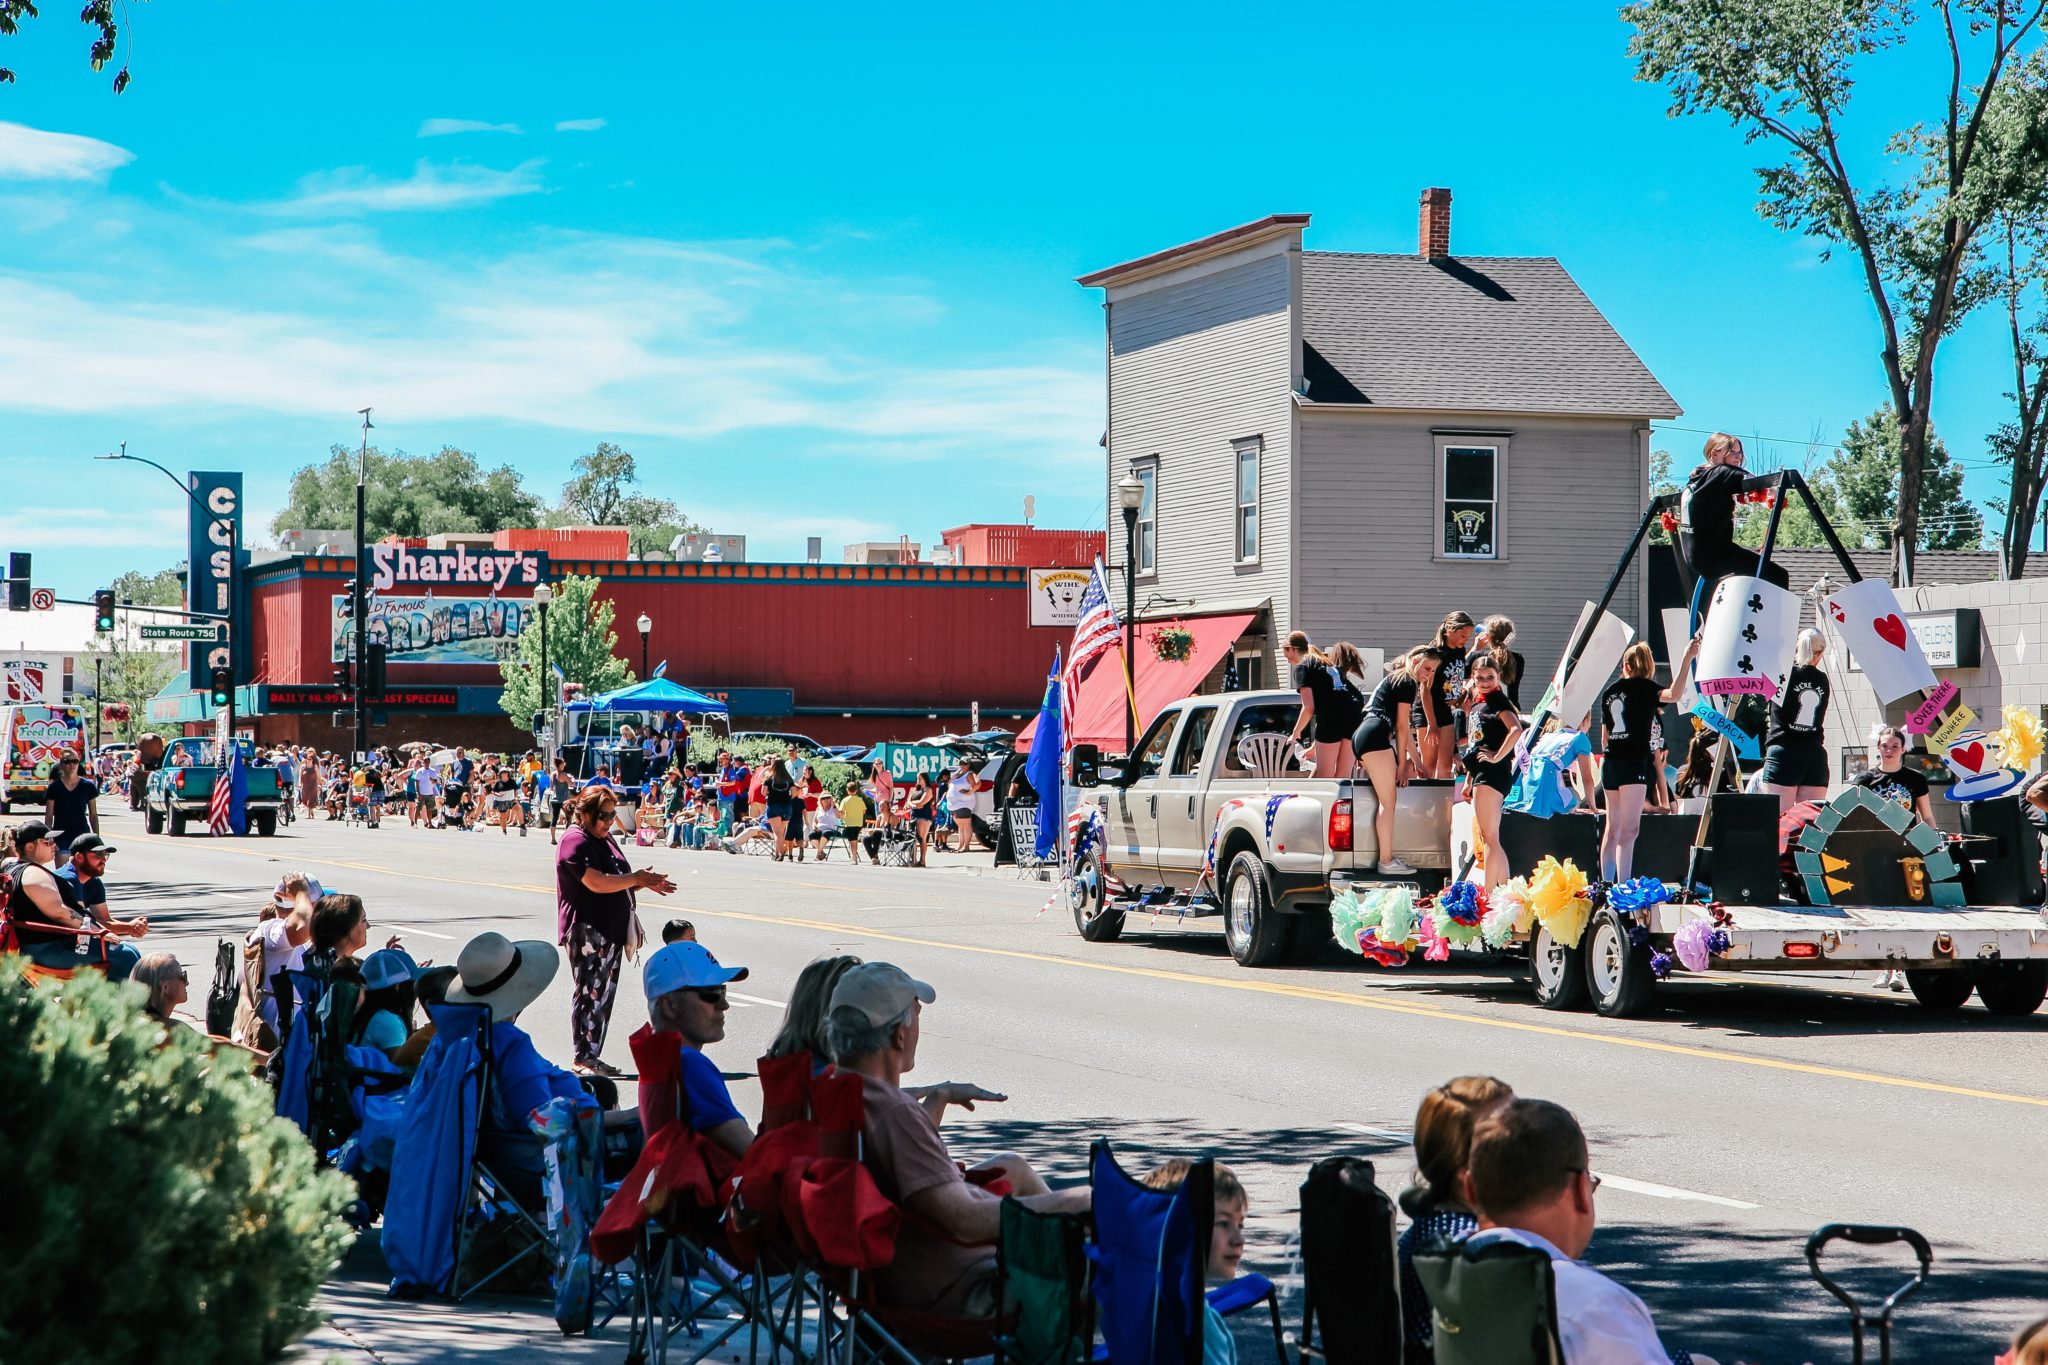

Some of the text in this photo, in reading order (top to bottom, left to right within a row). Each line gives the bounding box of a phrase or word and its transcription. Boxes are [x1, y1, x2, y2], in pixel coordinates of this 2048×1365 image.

[373, 543, 538, 590] Sharkey's
[142, 629, 215, 638] State Route 756
[1931, 650, 1951, 660] REPAIR
[1703, 680, 1765, 692] THIS WAY
[271, 693, 305, 703] DAILY
[405, 694, 456, 704] SPECIAL!
[1913, 681, 1952, 726] OVER THERE
[1698, 706, 1745, 744] GO BACK
[1935, 711, 1966, 746] NOWHERE
[19, 727, 77, 737] Food Closet
